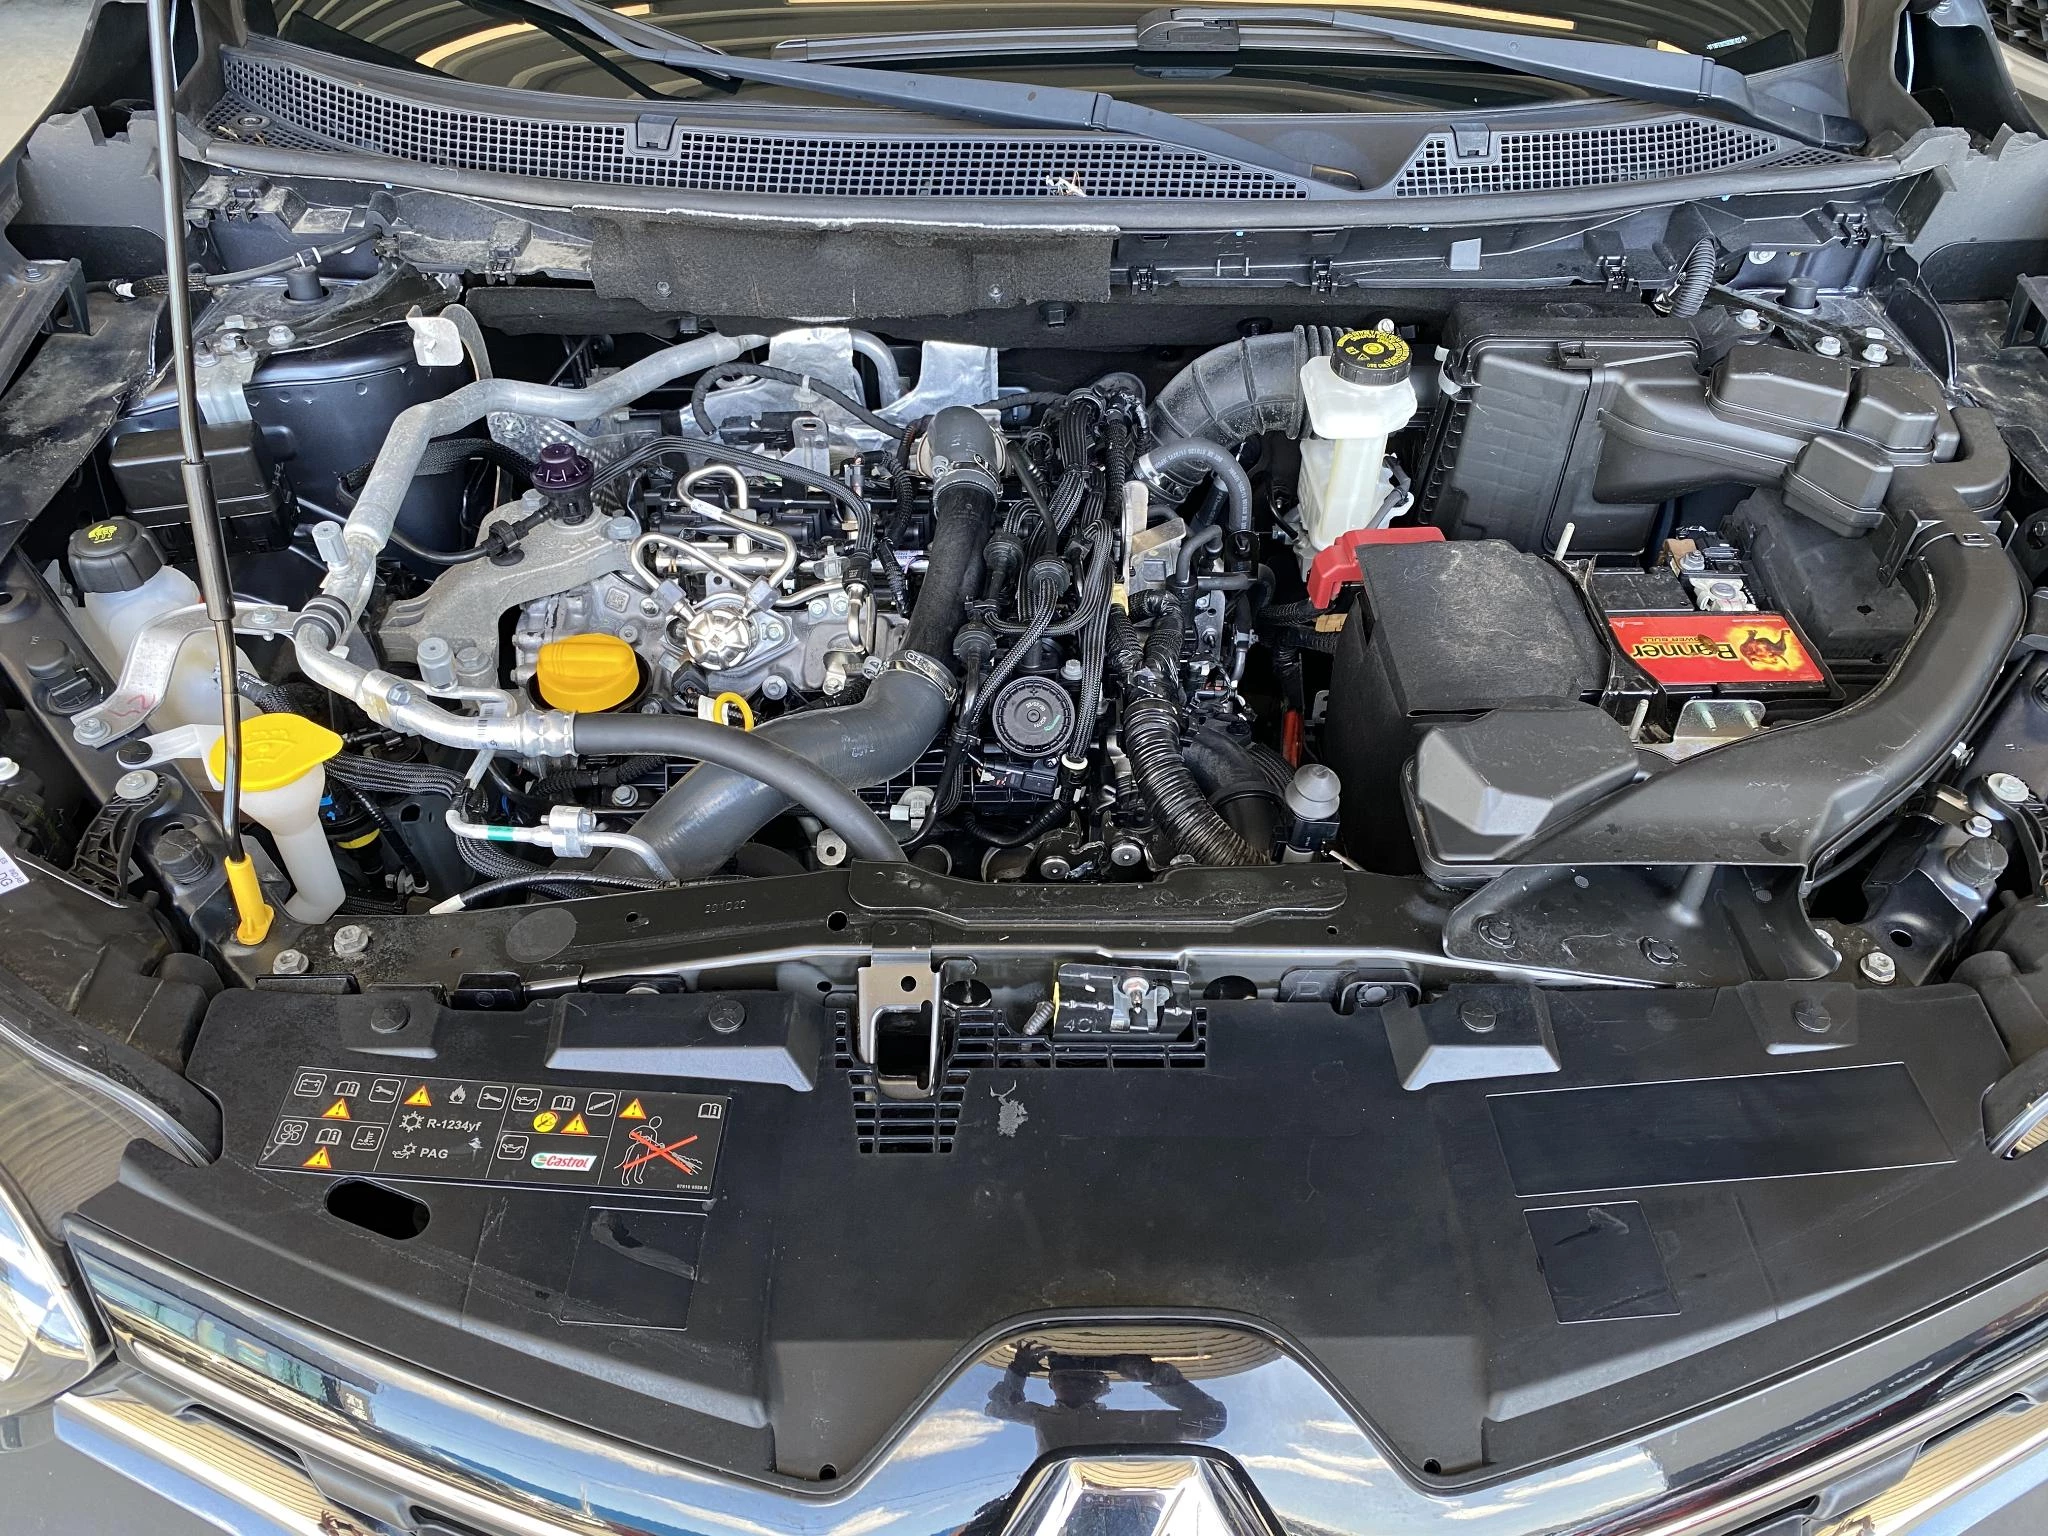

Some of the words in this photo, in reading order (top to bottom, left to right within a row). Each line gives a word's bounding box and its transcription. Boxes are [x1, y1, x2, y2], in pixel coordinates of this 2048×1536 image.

[1633, 643, 1739, 659] Banner
[426, 1118, 482, 1133] R-1234yf
[419, 1147, 449, 1160] PAG
[546, 1155, 588, 1168] Castrol
